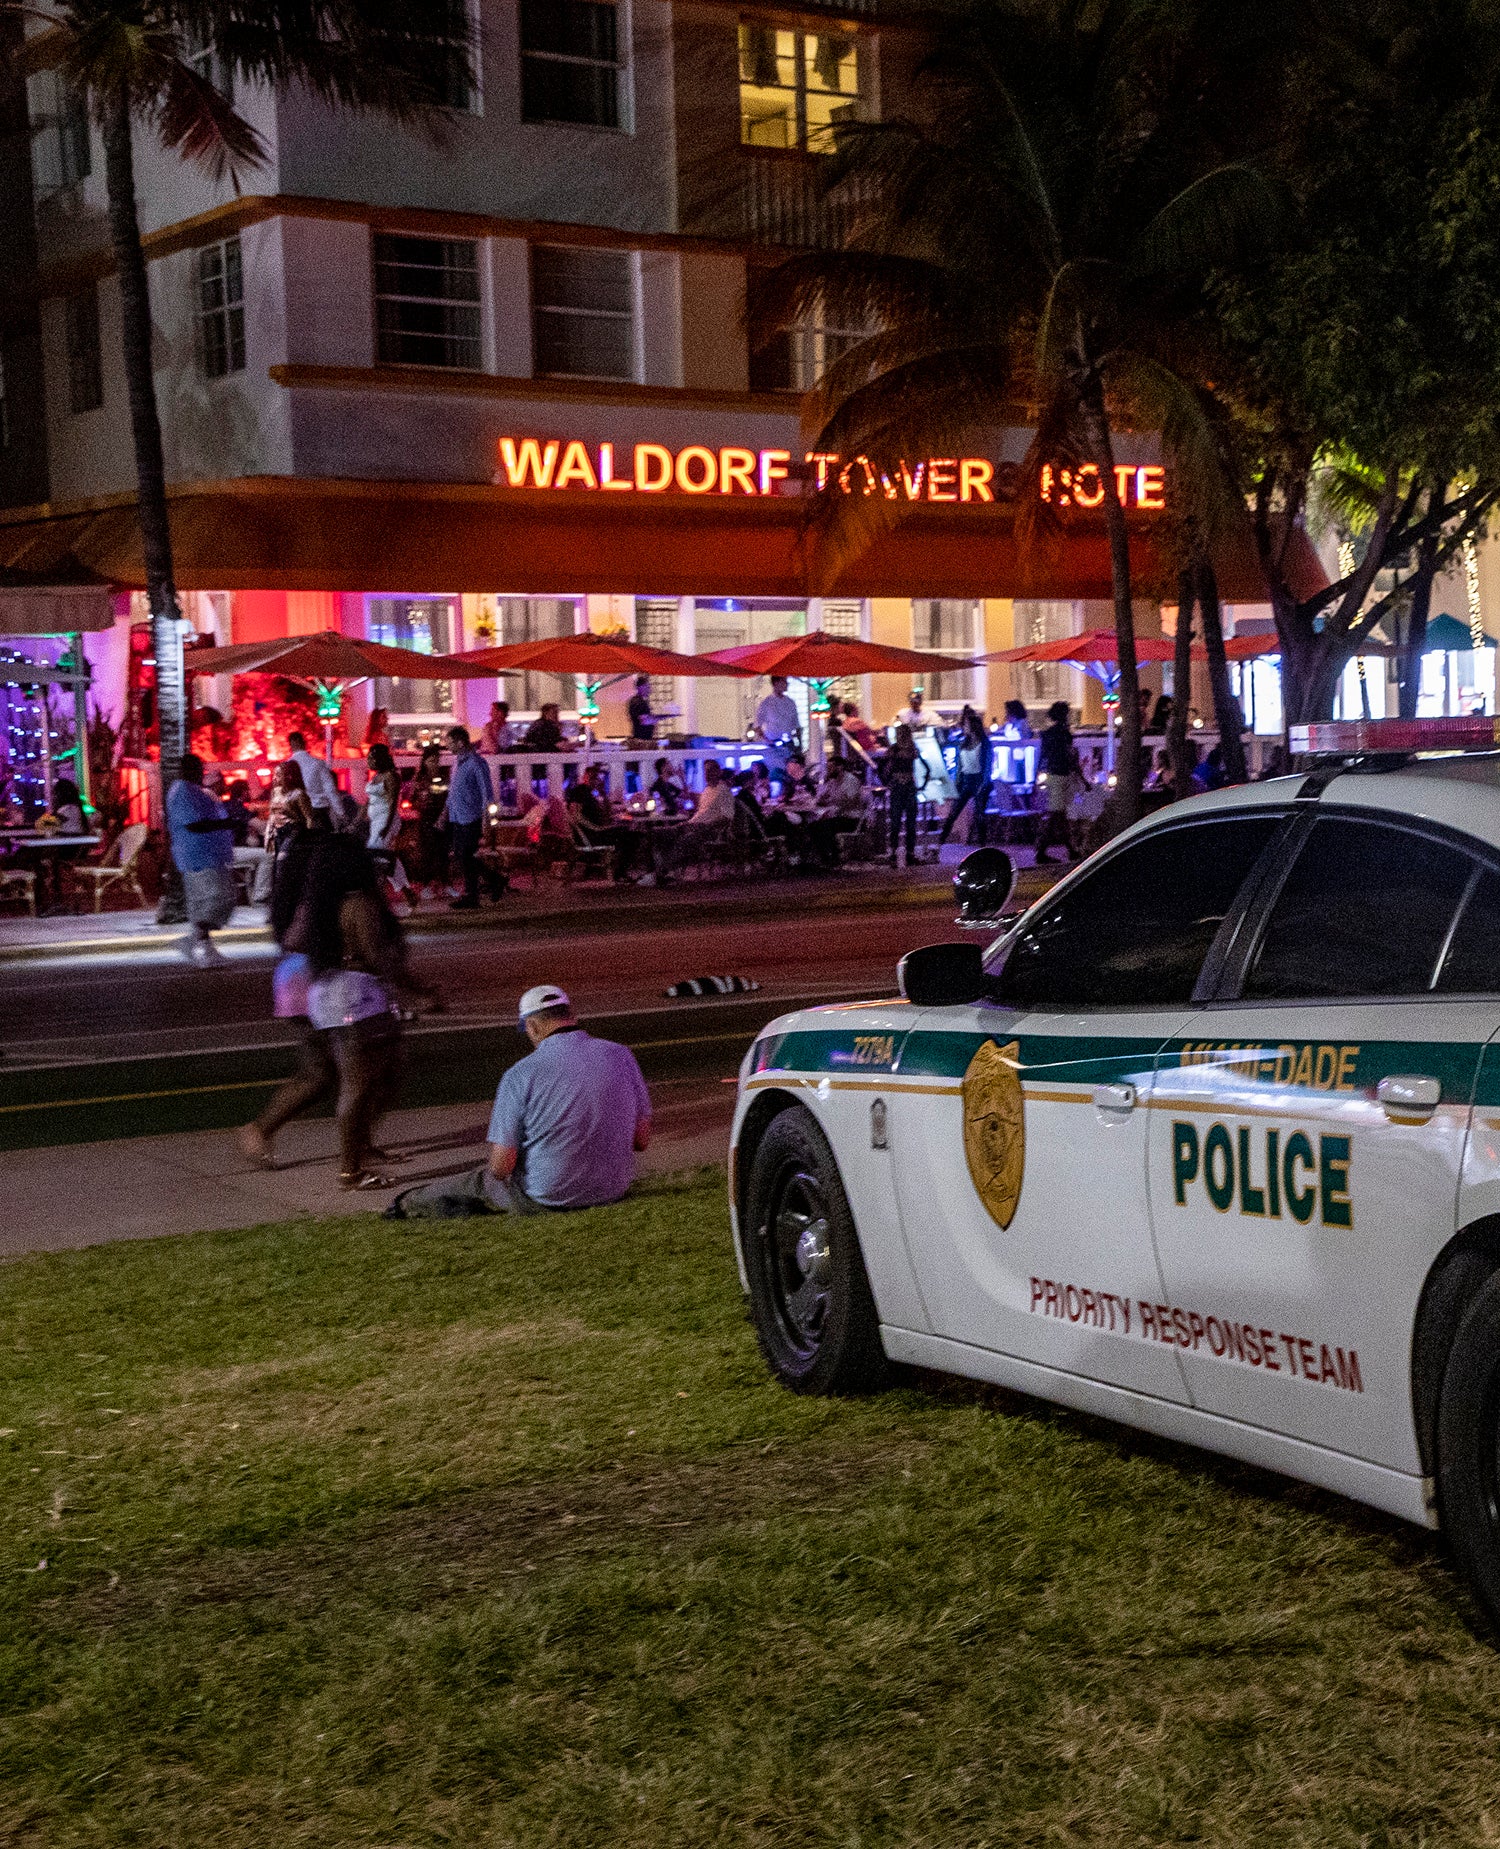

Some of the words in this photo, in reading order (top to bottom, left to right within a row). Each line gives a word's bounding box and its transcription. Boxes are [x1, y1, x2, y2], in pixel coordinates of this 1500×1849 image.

[499, 437, 791, 496] WALDORF
[1171, 1120, 1354, 1231] POLICE
[1030, 1276, 1133, 1336] PRIORITY
[1138, 1300, 1279, 1373] RESPONSE
[1277, 1332, 1366, 1394] TEAM
